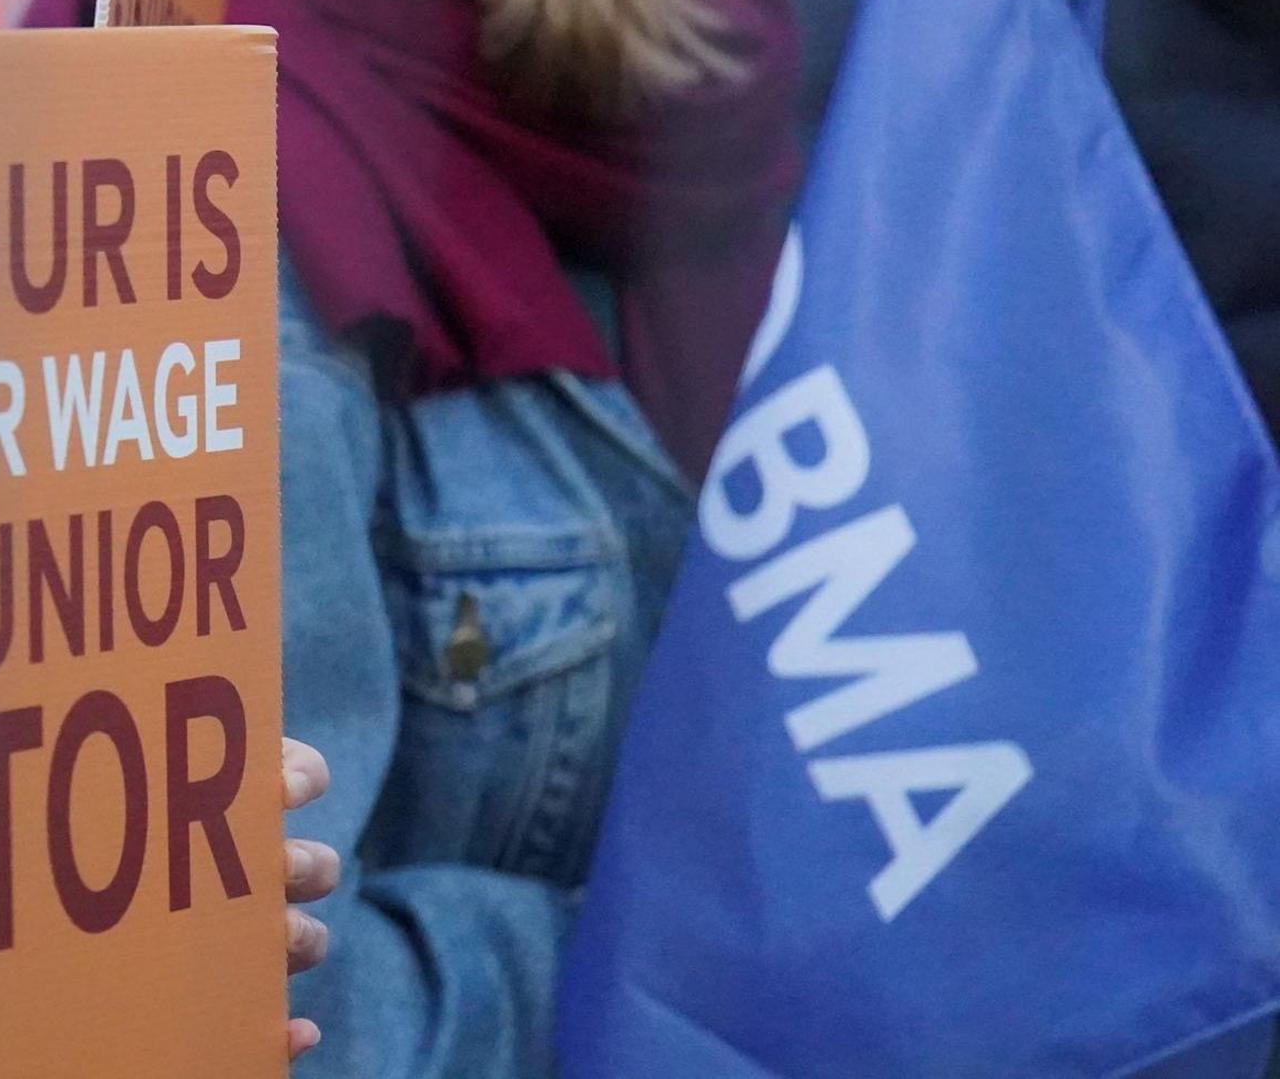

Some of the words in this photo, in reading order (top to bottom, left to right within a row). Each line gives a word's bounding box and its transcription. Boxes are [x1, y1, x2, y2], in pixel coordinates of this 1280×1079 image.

[166, 149, 241, 301] IS
[42, 338, 243, 471] WAGE
[697, 363, 1035, 923] BMA
